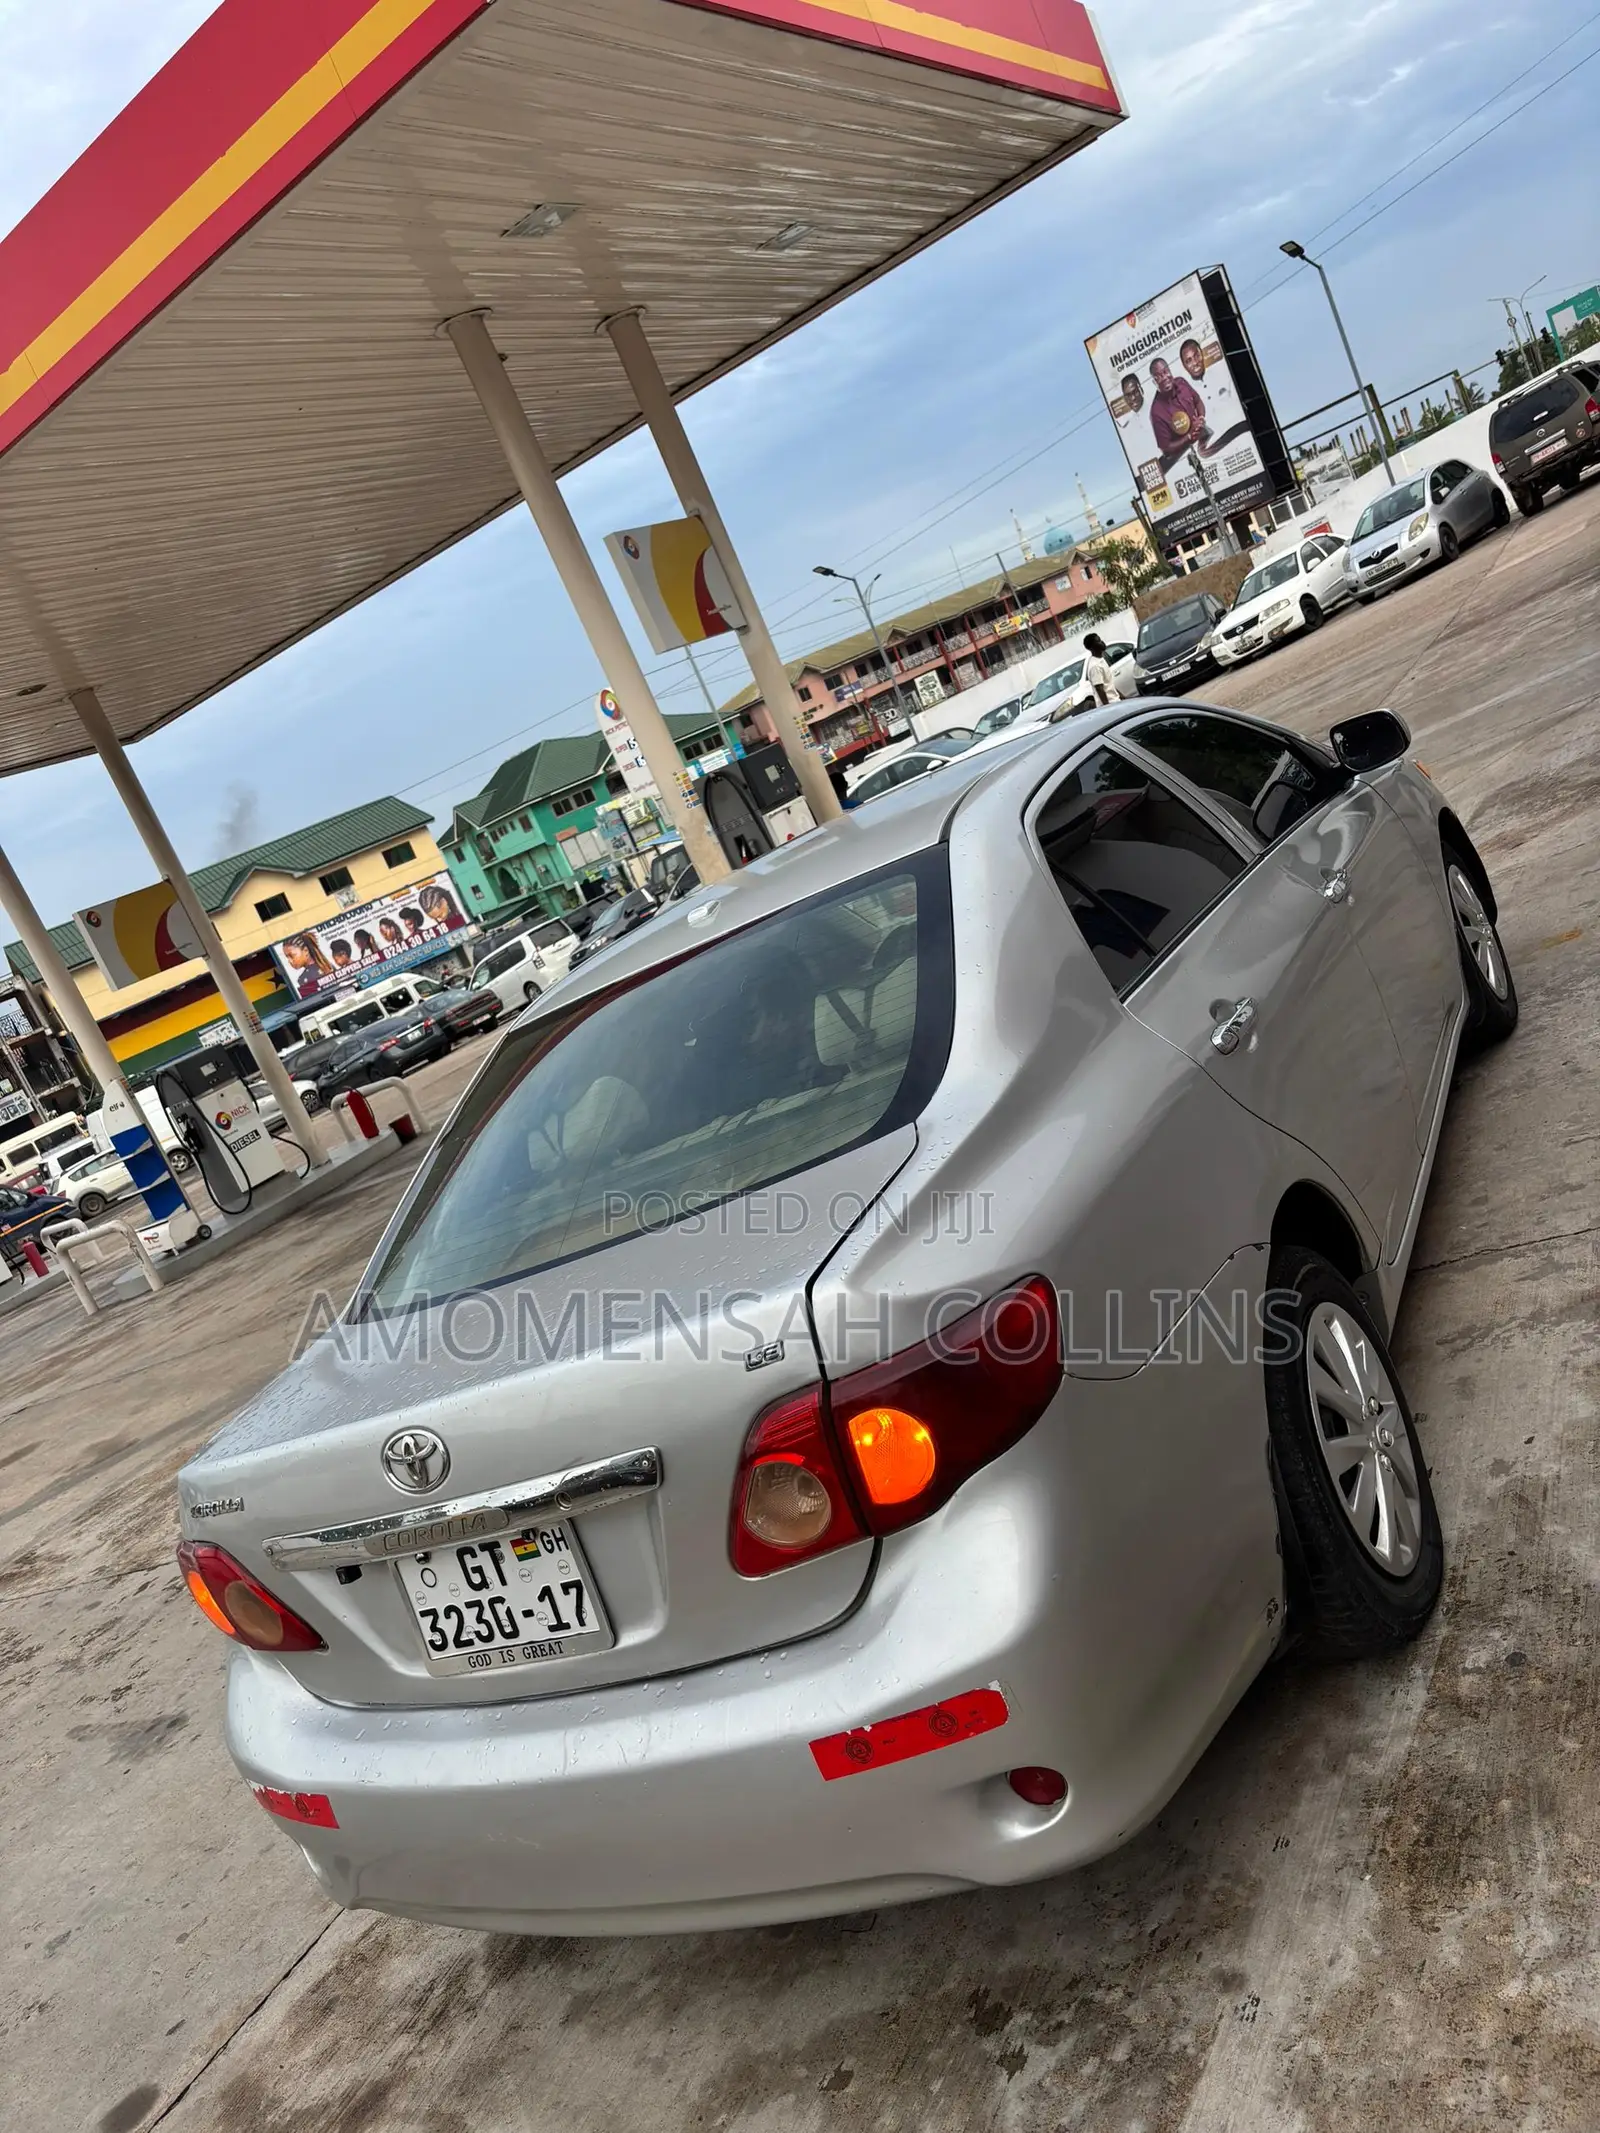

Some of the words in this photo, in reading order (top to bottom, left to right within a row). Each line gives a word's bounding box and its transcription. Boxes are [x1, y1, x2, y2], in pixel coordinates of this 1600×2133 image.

[1109, 308, 1193, 368] INAUGURATION
[1117, 364, 1126, 373] OF
[1126, 357, 1139, 368] NEW
[1139, 341, 1164, 360] CHURCH
[1163, 324, 1192, 346] BUILDING
[1151, 490, 1168, 503] 2PM
[1176, 480, 1187, 498] 3
[1187, 478, 1198, 487] ALL
[1188, 476, 1220, 492] SERCES
[383, 942, 409, 960] 0244
[410, 934, 423, 948] 30
[423, 929, 437, 942] 64
[438, 922, 449, 937] 18
[336, 961, 362, 982] CLIPPERS
[361, 953, 380, 969] SALON
[231, 1103, 250, 1118] NICK
[230, 1131, 261, 1152] DIESEL
[747, 1343, 781, 1368] LE
[383, 1513, 487, 1551] COROLLA
[456, 1540, 508, 1592] GT
[539, 1527, 570, 1554] GH
[419, 1578, 587, 1652] 3230-17
[468, 1652, 493, 1669] GOD
[501, 1649, 516, 1664] IS
[522, 1641, 564, 1661] GREAT
